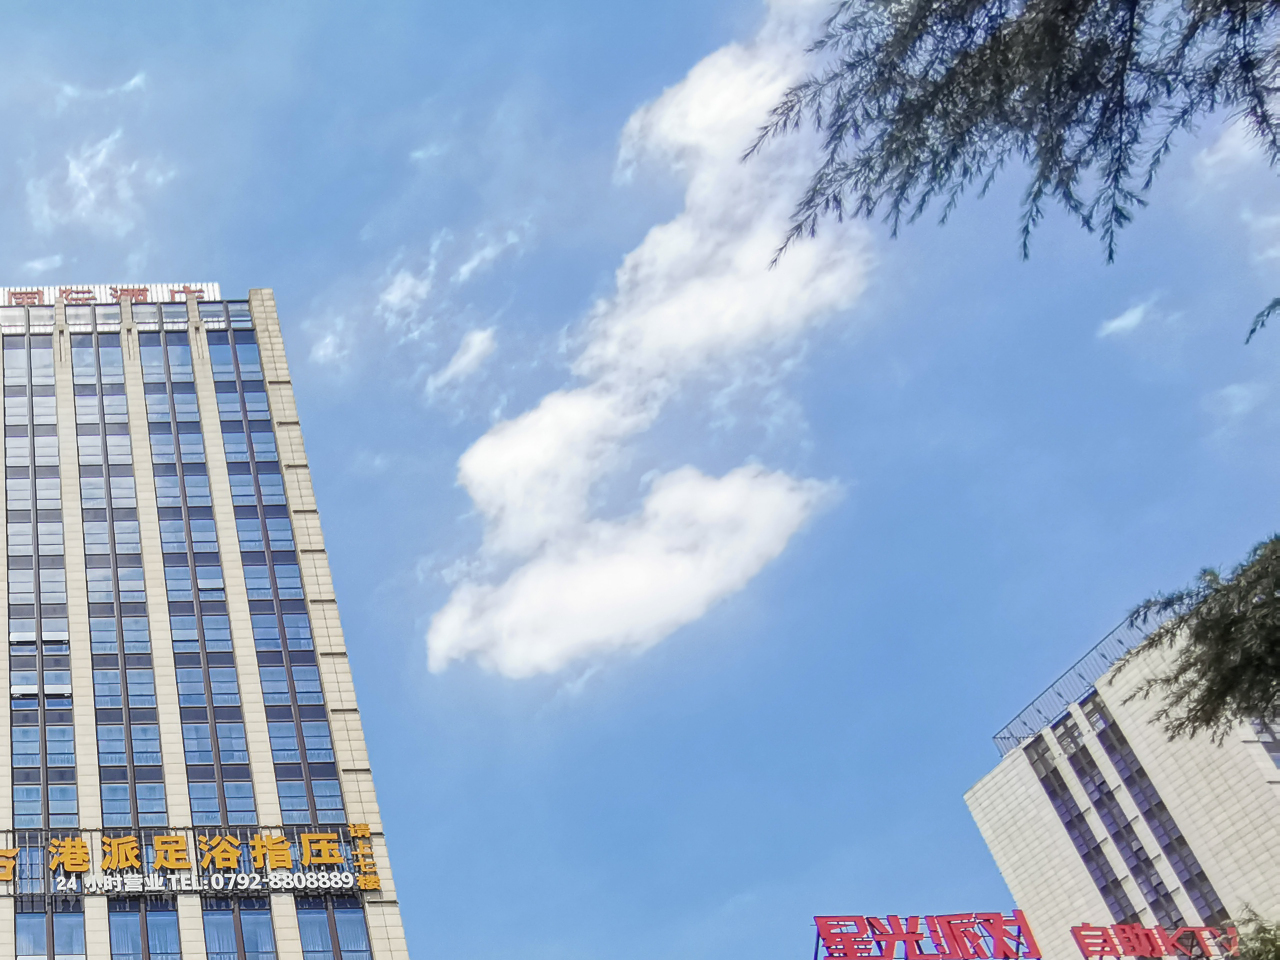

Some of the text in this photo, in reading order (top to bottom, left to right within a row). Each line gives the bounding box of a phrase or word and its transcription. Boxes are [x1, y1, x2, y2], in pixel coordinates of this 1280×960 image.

[48, 833, 344, 872] 港派足浴指压
[348, 824, 381, 890] 请上七楼
[1070, 922, 1240, 957] 自助KTV
